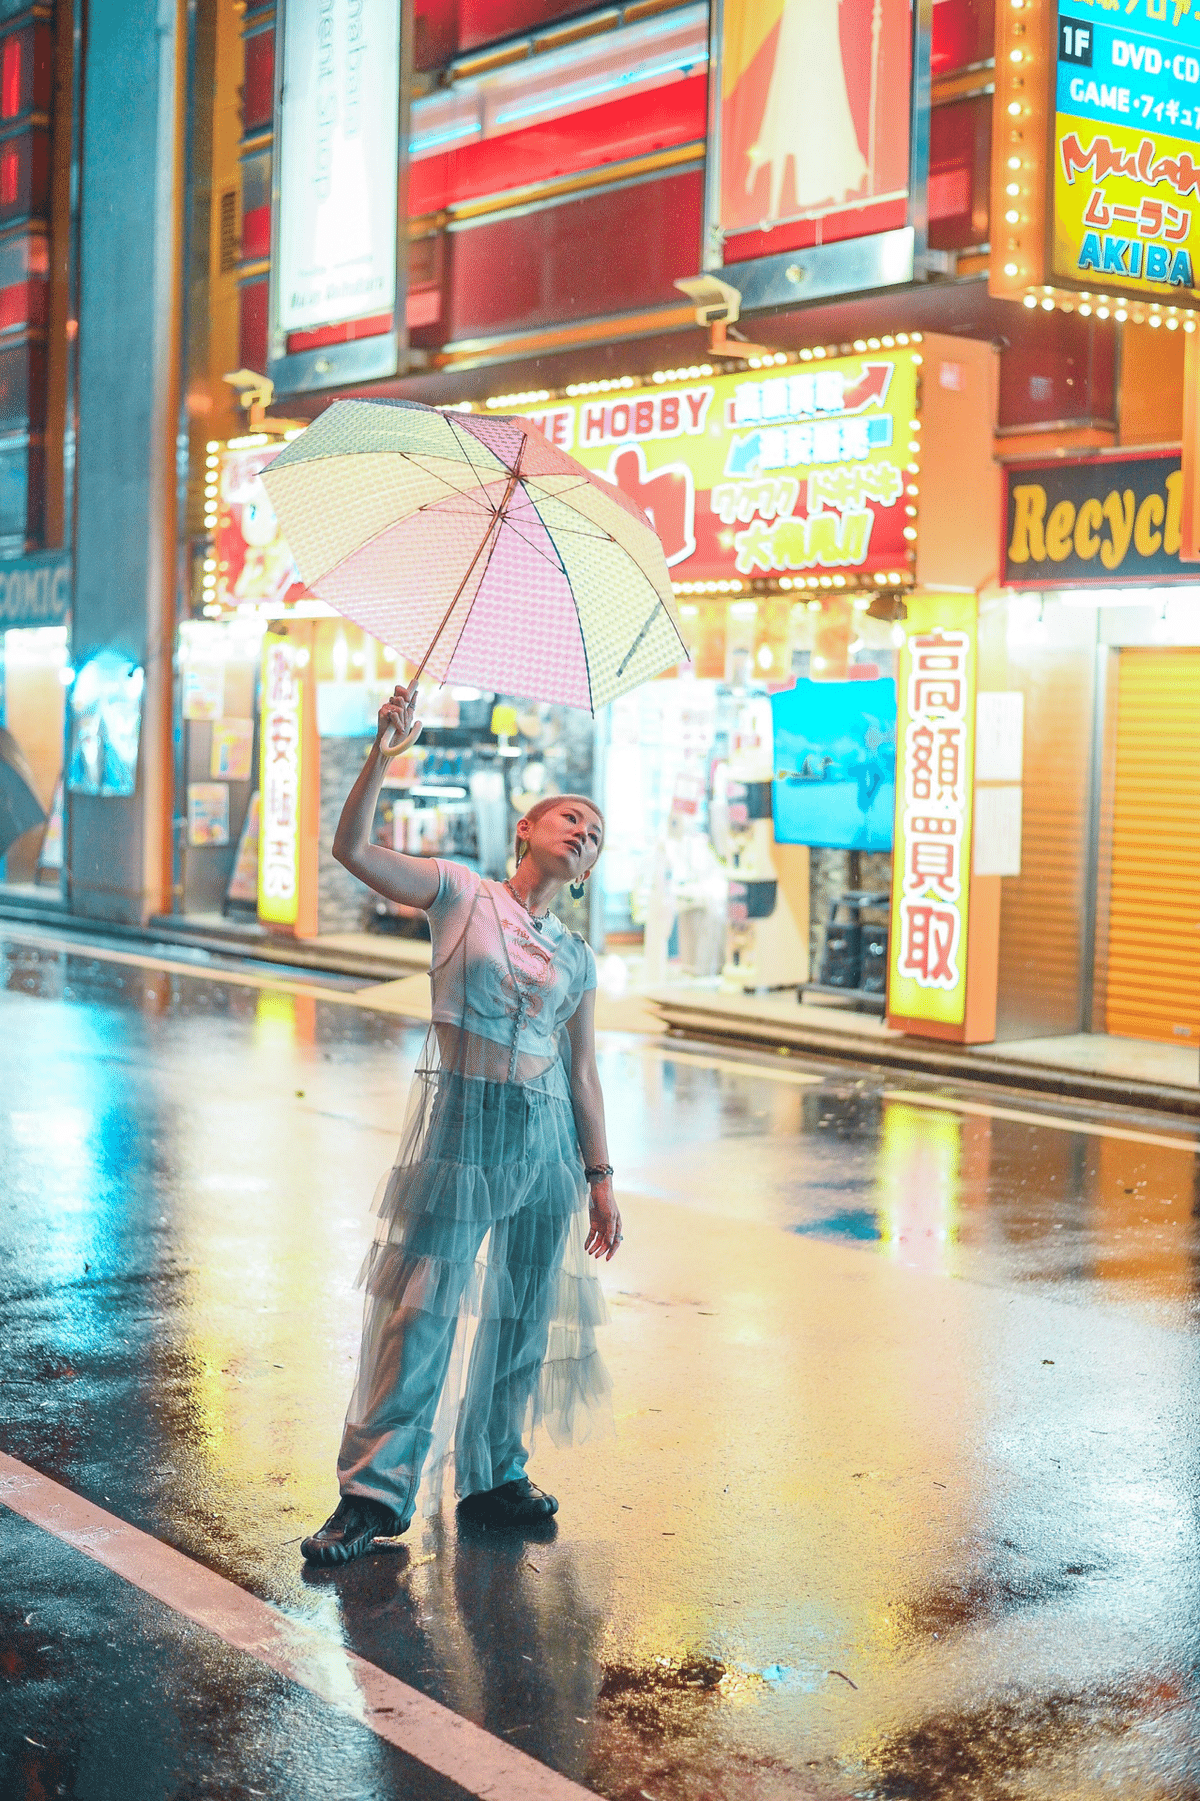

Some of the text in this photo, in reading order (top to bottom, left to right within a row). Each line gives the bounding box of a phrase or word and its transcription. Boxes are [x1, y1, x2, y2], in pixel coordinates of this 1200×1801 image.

[1063, 25, 1090, 57] 1F
[1084, 189, 1190, 241] ムーラン
[1078, 233, 1194, 287] AKIBA
[585, 391, 708, 441] HOBBY
[903, 631, 966, 983] 高額買取
